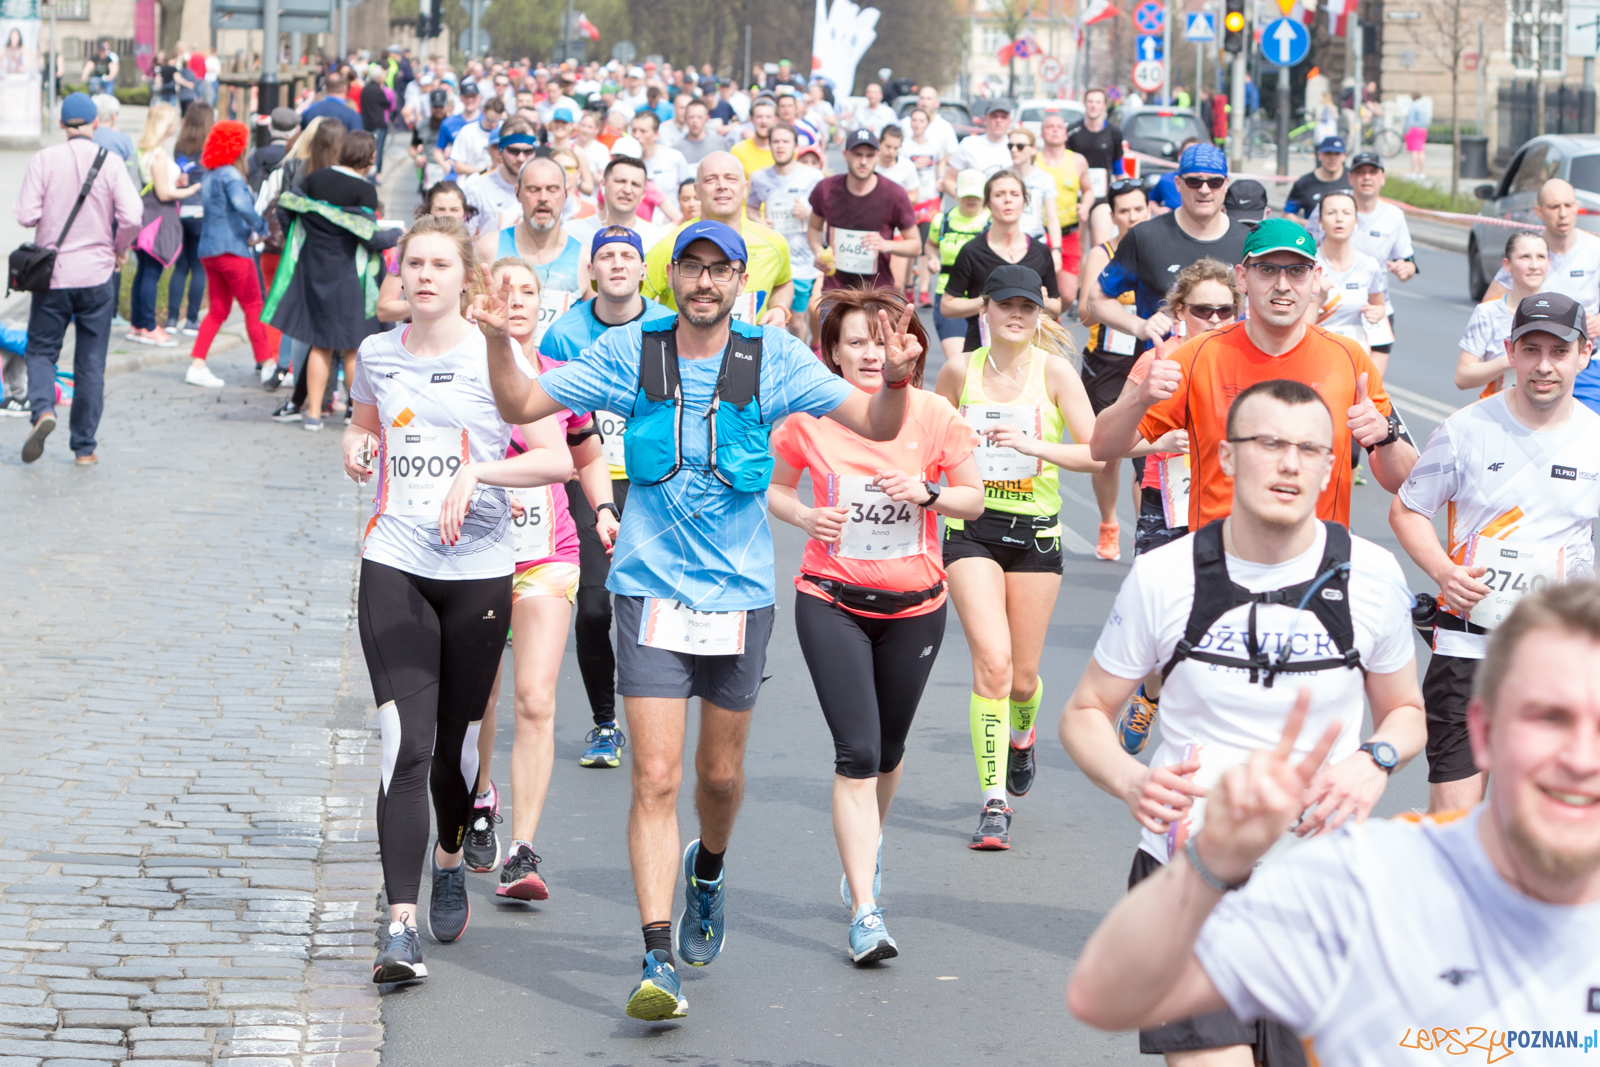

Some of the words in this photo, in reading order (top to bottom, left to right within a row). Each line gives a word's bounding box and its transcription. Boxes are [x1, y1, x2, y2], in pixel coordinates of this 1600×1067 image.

[1138, 67, 1160, 81] 40
[839, 242, 869, 255] 6482
[390, 455, 461, 478] 10909
[985, 486, 1036, 502] nners
[1182, 477, 1191, 495] 2
[851, 502, 912, 525] 3424
[687, 618, 711, 629] Maciej
